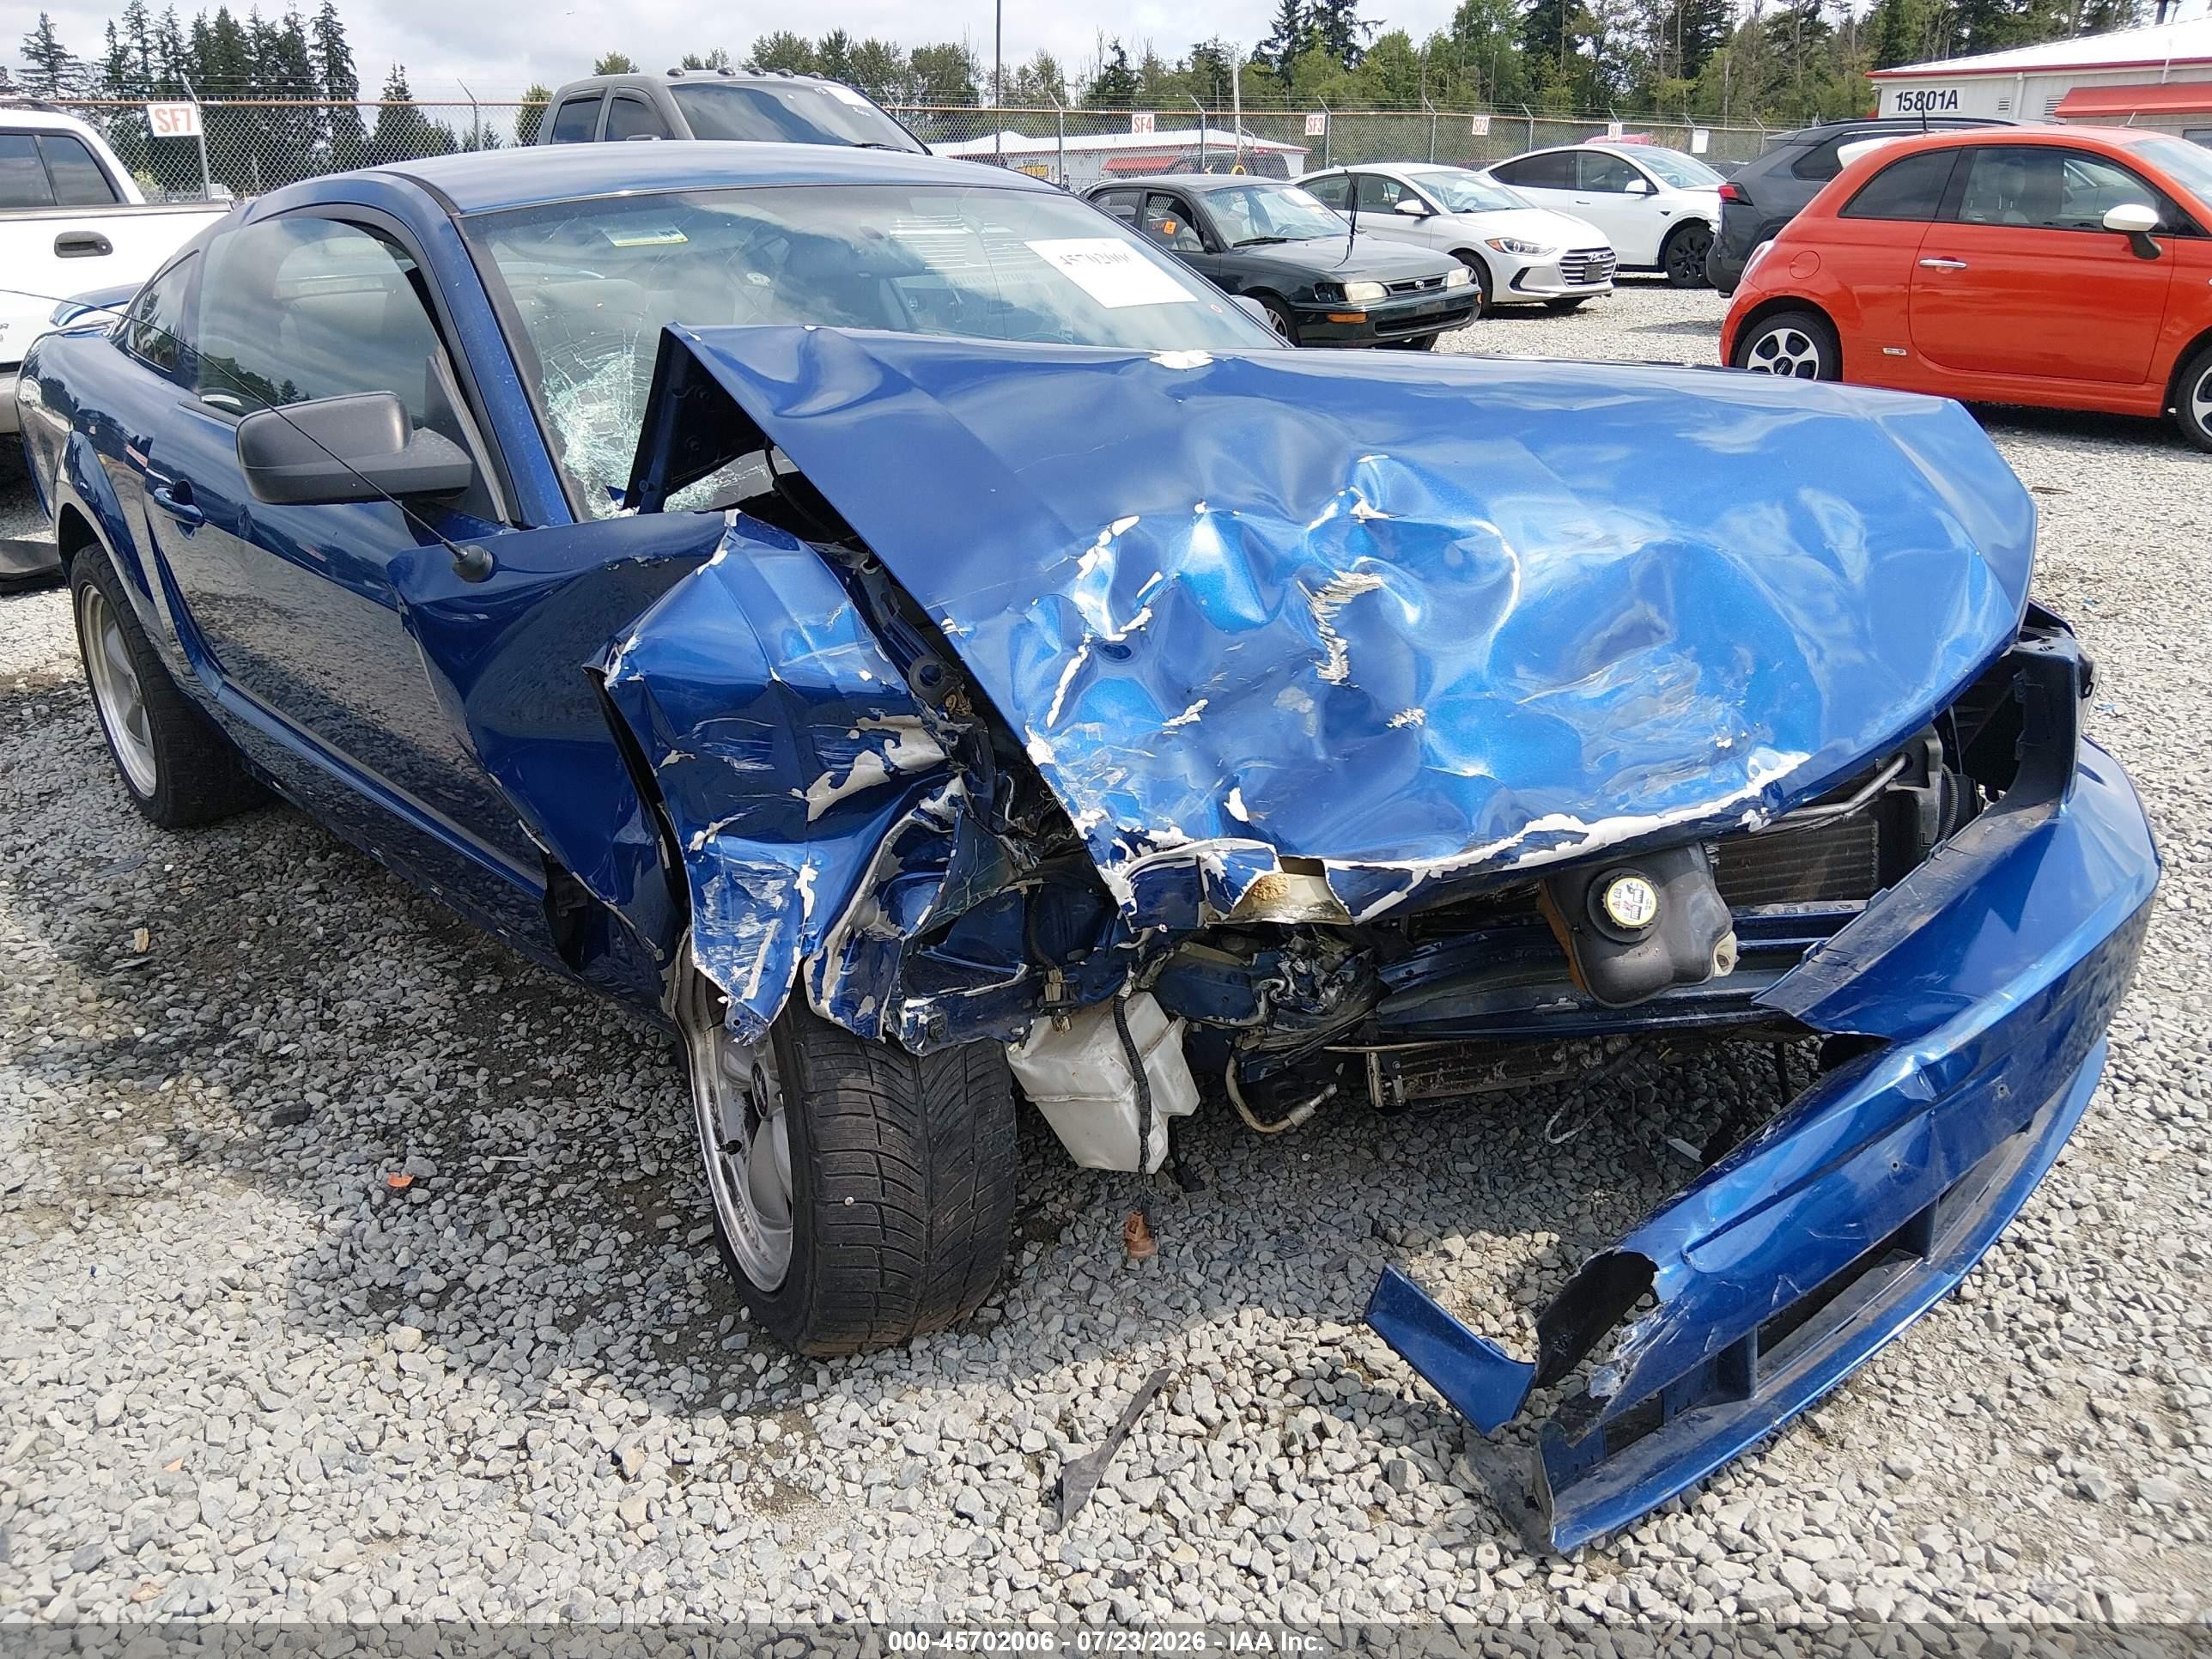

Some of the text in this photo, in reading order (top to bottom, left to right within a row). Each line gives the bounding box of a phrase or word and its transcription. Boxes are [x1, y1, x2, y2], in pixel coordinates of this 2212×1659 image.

[1895, 89, 1958, 112] 15801A
[155, 108, 191, 132] SF7
[1133, 116, 1152, 133] SF4
[1308, 117, 1323, 132] SF3
[1474, 118, 1487, 132] SF2
[1610, 125, 1621, 138] SF1
